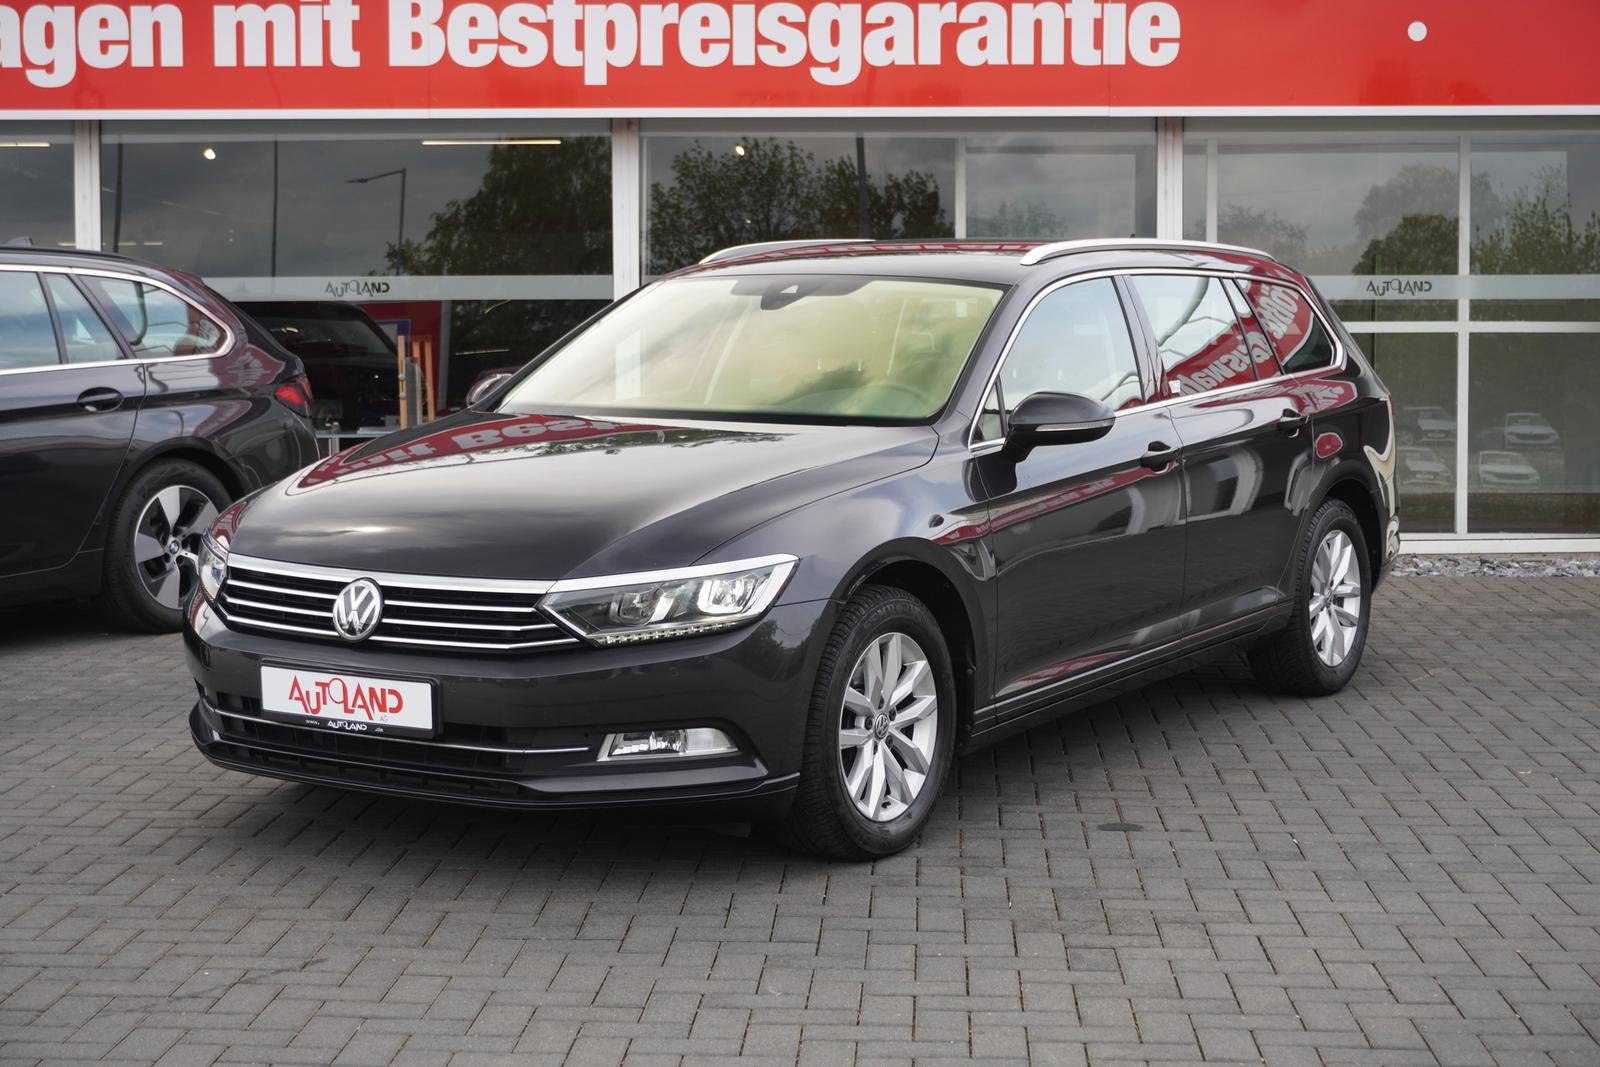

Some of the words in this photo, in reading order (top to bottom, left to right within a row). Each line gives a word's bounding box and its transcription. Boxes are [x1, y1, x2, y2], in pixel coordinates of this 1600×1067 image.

[213, 0, 361, 67] mit
[388, 0, 1181, 86] Bestpreisgarantie
[288, 674, 404, 721] AUTOLAND
